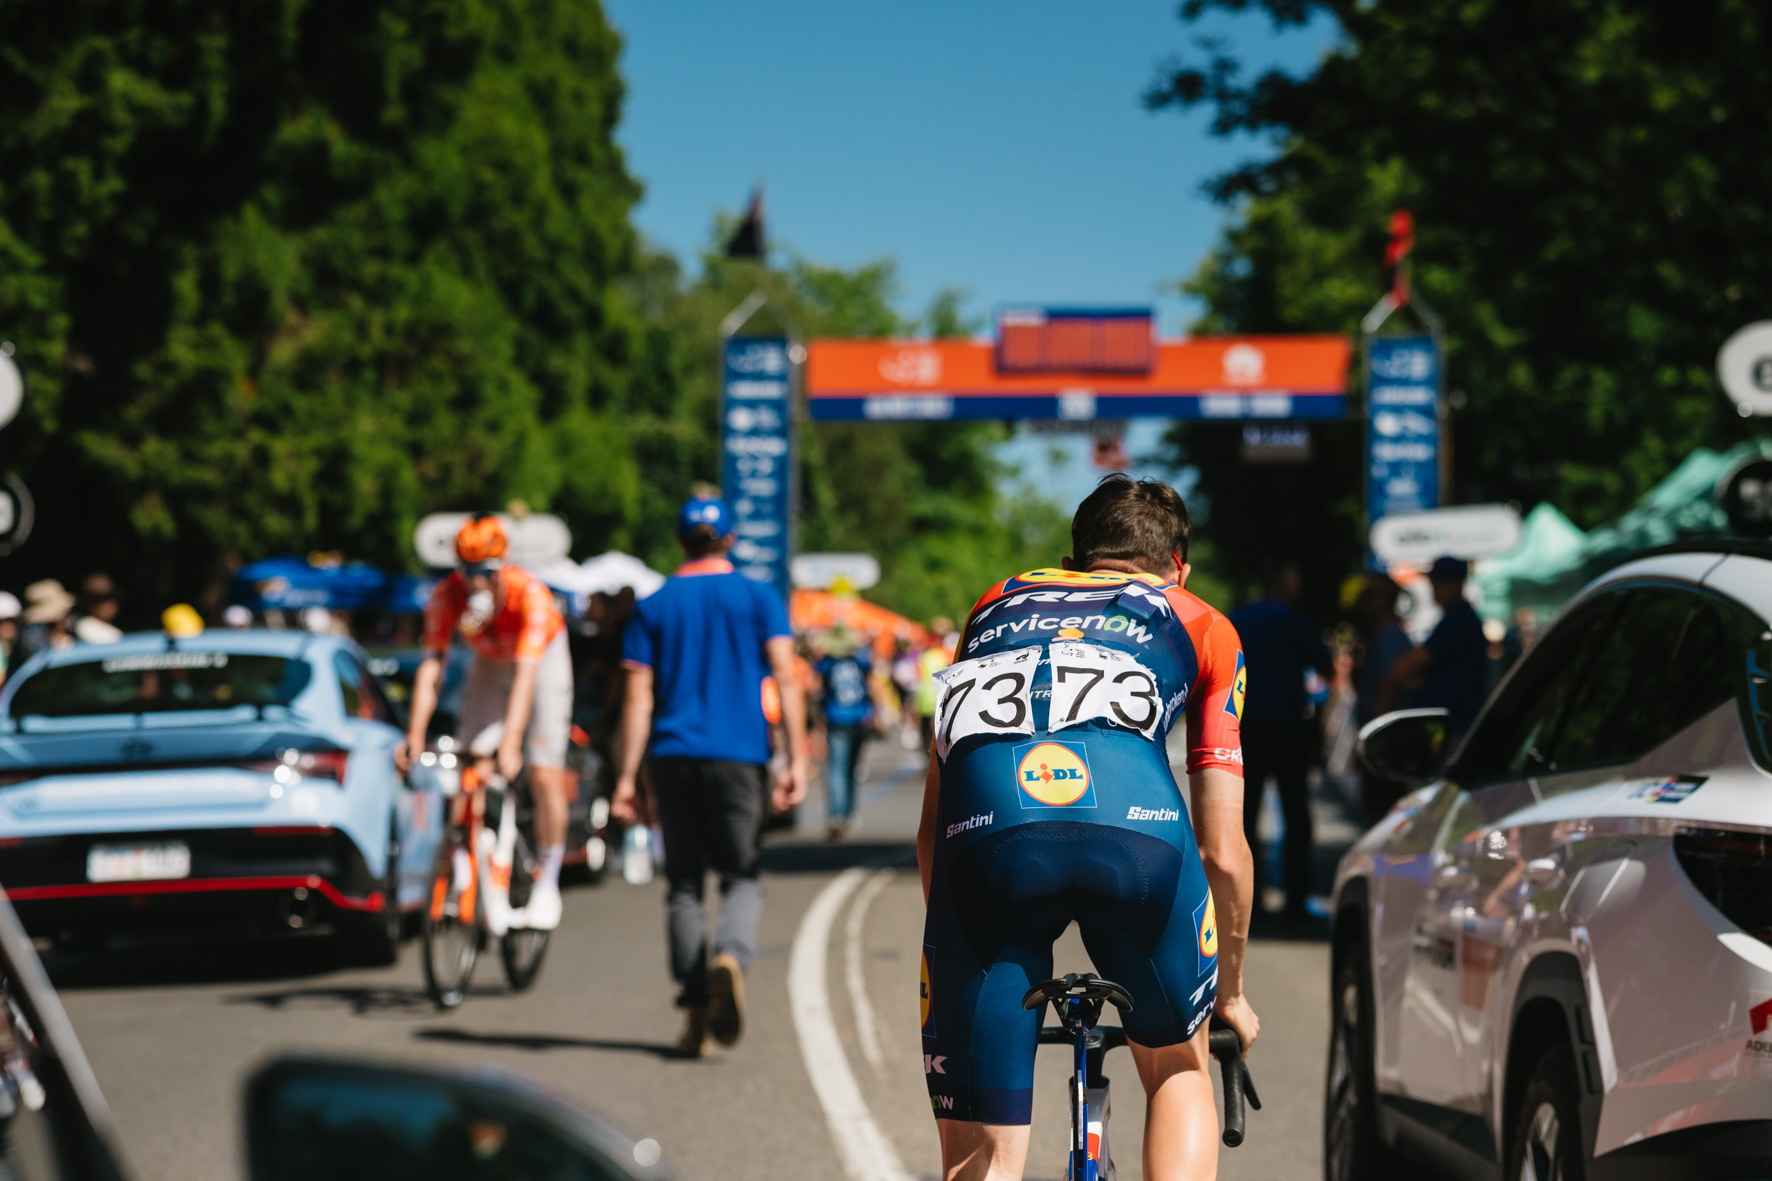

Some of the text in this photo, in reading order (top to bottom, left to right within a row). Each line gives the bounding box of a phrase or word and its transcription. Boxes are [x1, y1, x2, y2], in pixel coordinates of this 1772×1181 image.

[971, 584, 1173, 625] TREK
[968, 614, 1153, 653] servicenow
[940, 672, 1026, 746] 73
[1057, 666, 1157, 731] 73
[946, 811, 994, 839] Santini
[1126, 806, 1179, 821] Santini
